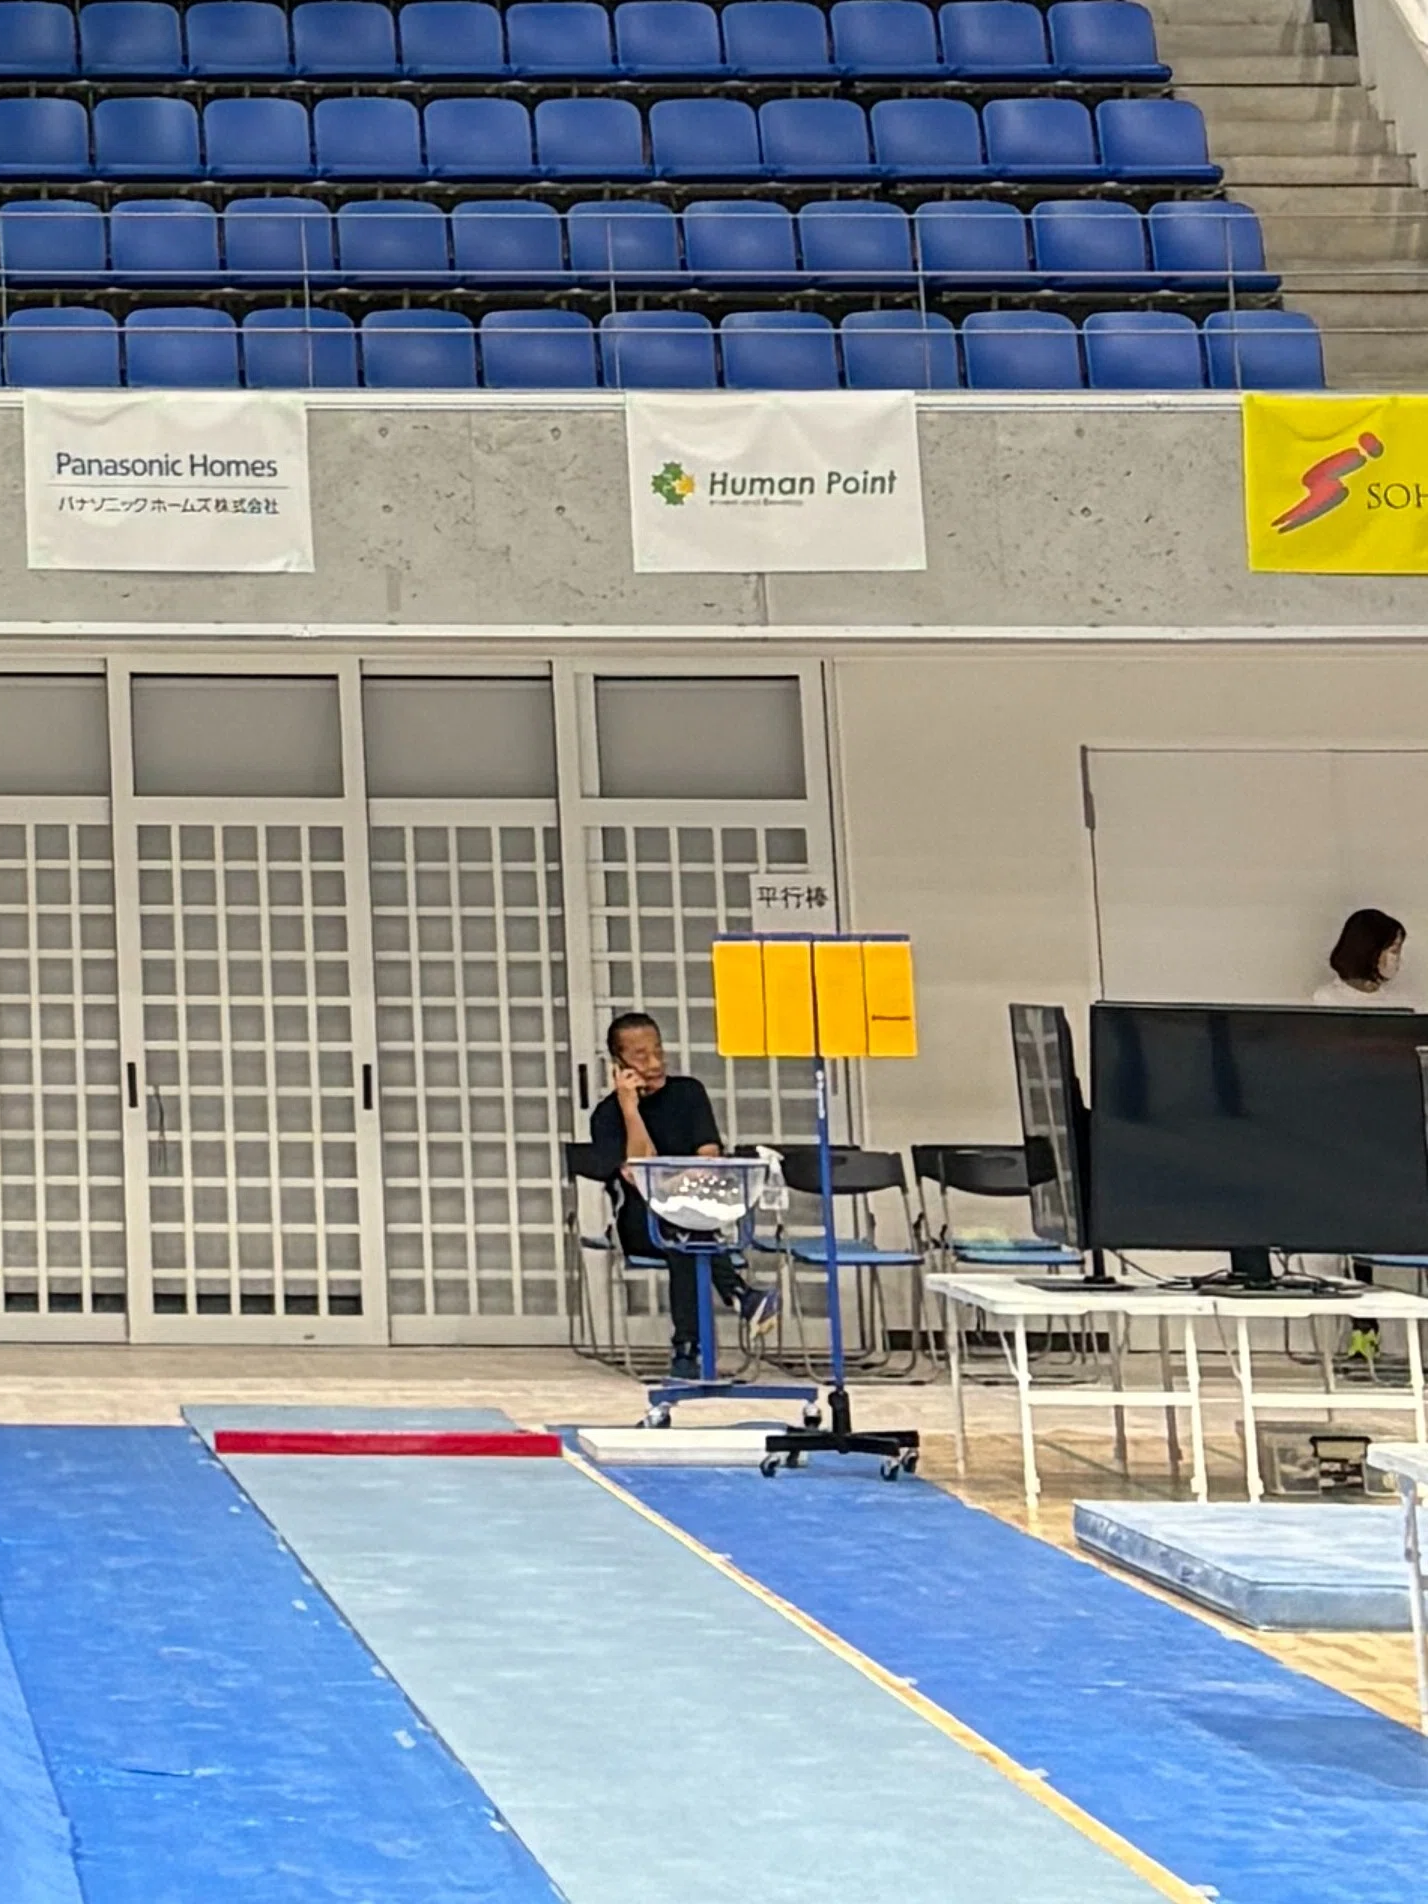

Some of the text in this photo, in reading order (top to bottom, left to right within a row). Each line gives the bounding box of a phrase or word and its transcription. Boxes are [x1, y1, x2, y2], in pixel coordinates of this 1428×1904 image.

[56, 452, 279, 479] Panasonic Homes
[709, 470, 897, 496] Human Point
[757, 885, 829, 909] 平行棒
